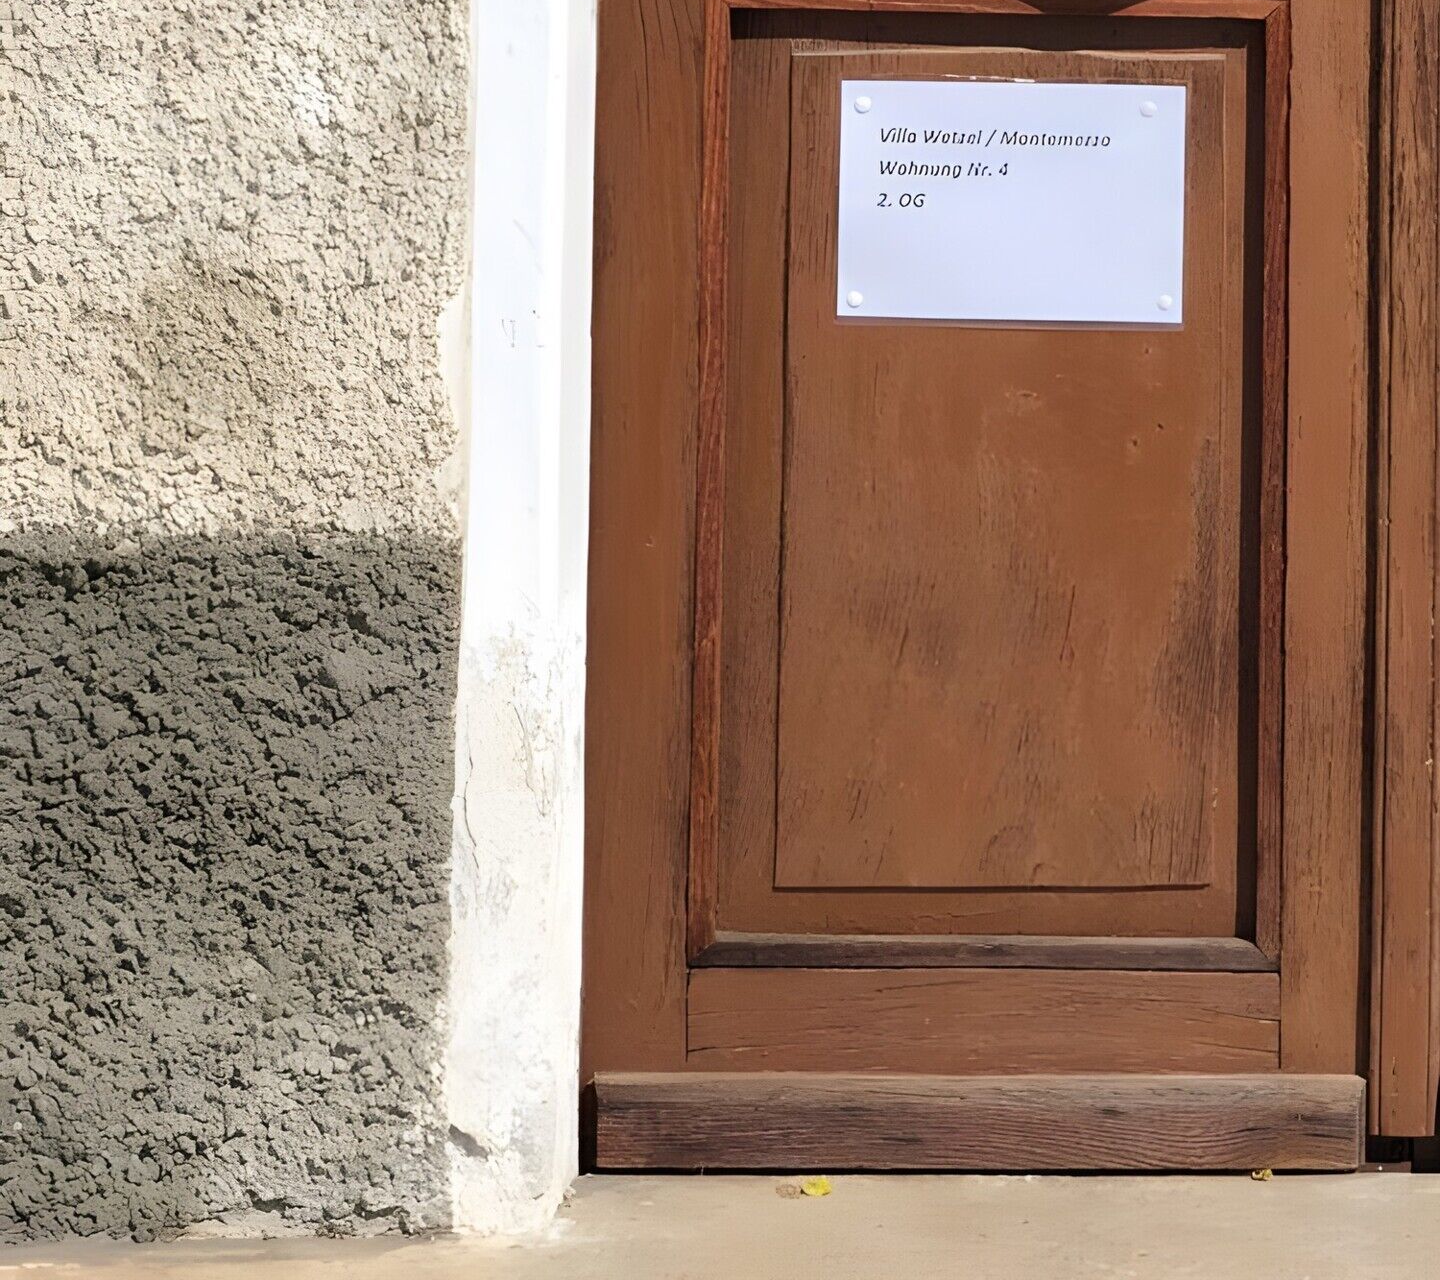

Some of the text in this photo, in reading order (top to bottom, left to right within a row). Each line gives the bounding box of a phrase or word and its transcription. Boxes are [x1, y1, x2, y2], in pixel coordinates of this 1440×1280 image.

[880, 127, 917, 144] Villa
[984, 129, 998, 148] /
[879, 160, 962, 179] Wohnung
[876, 192, 926, 208] 2. OG
